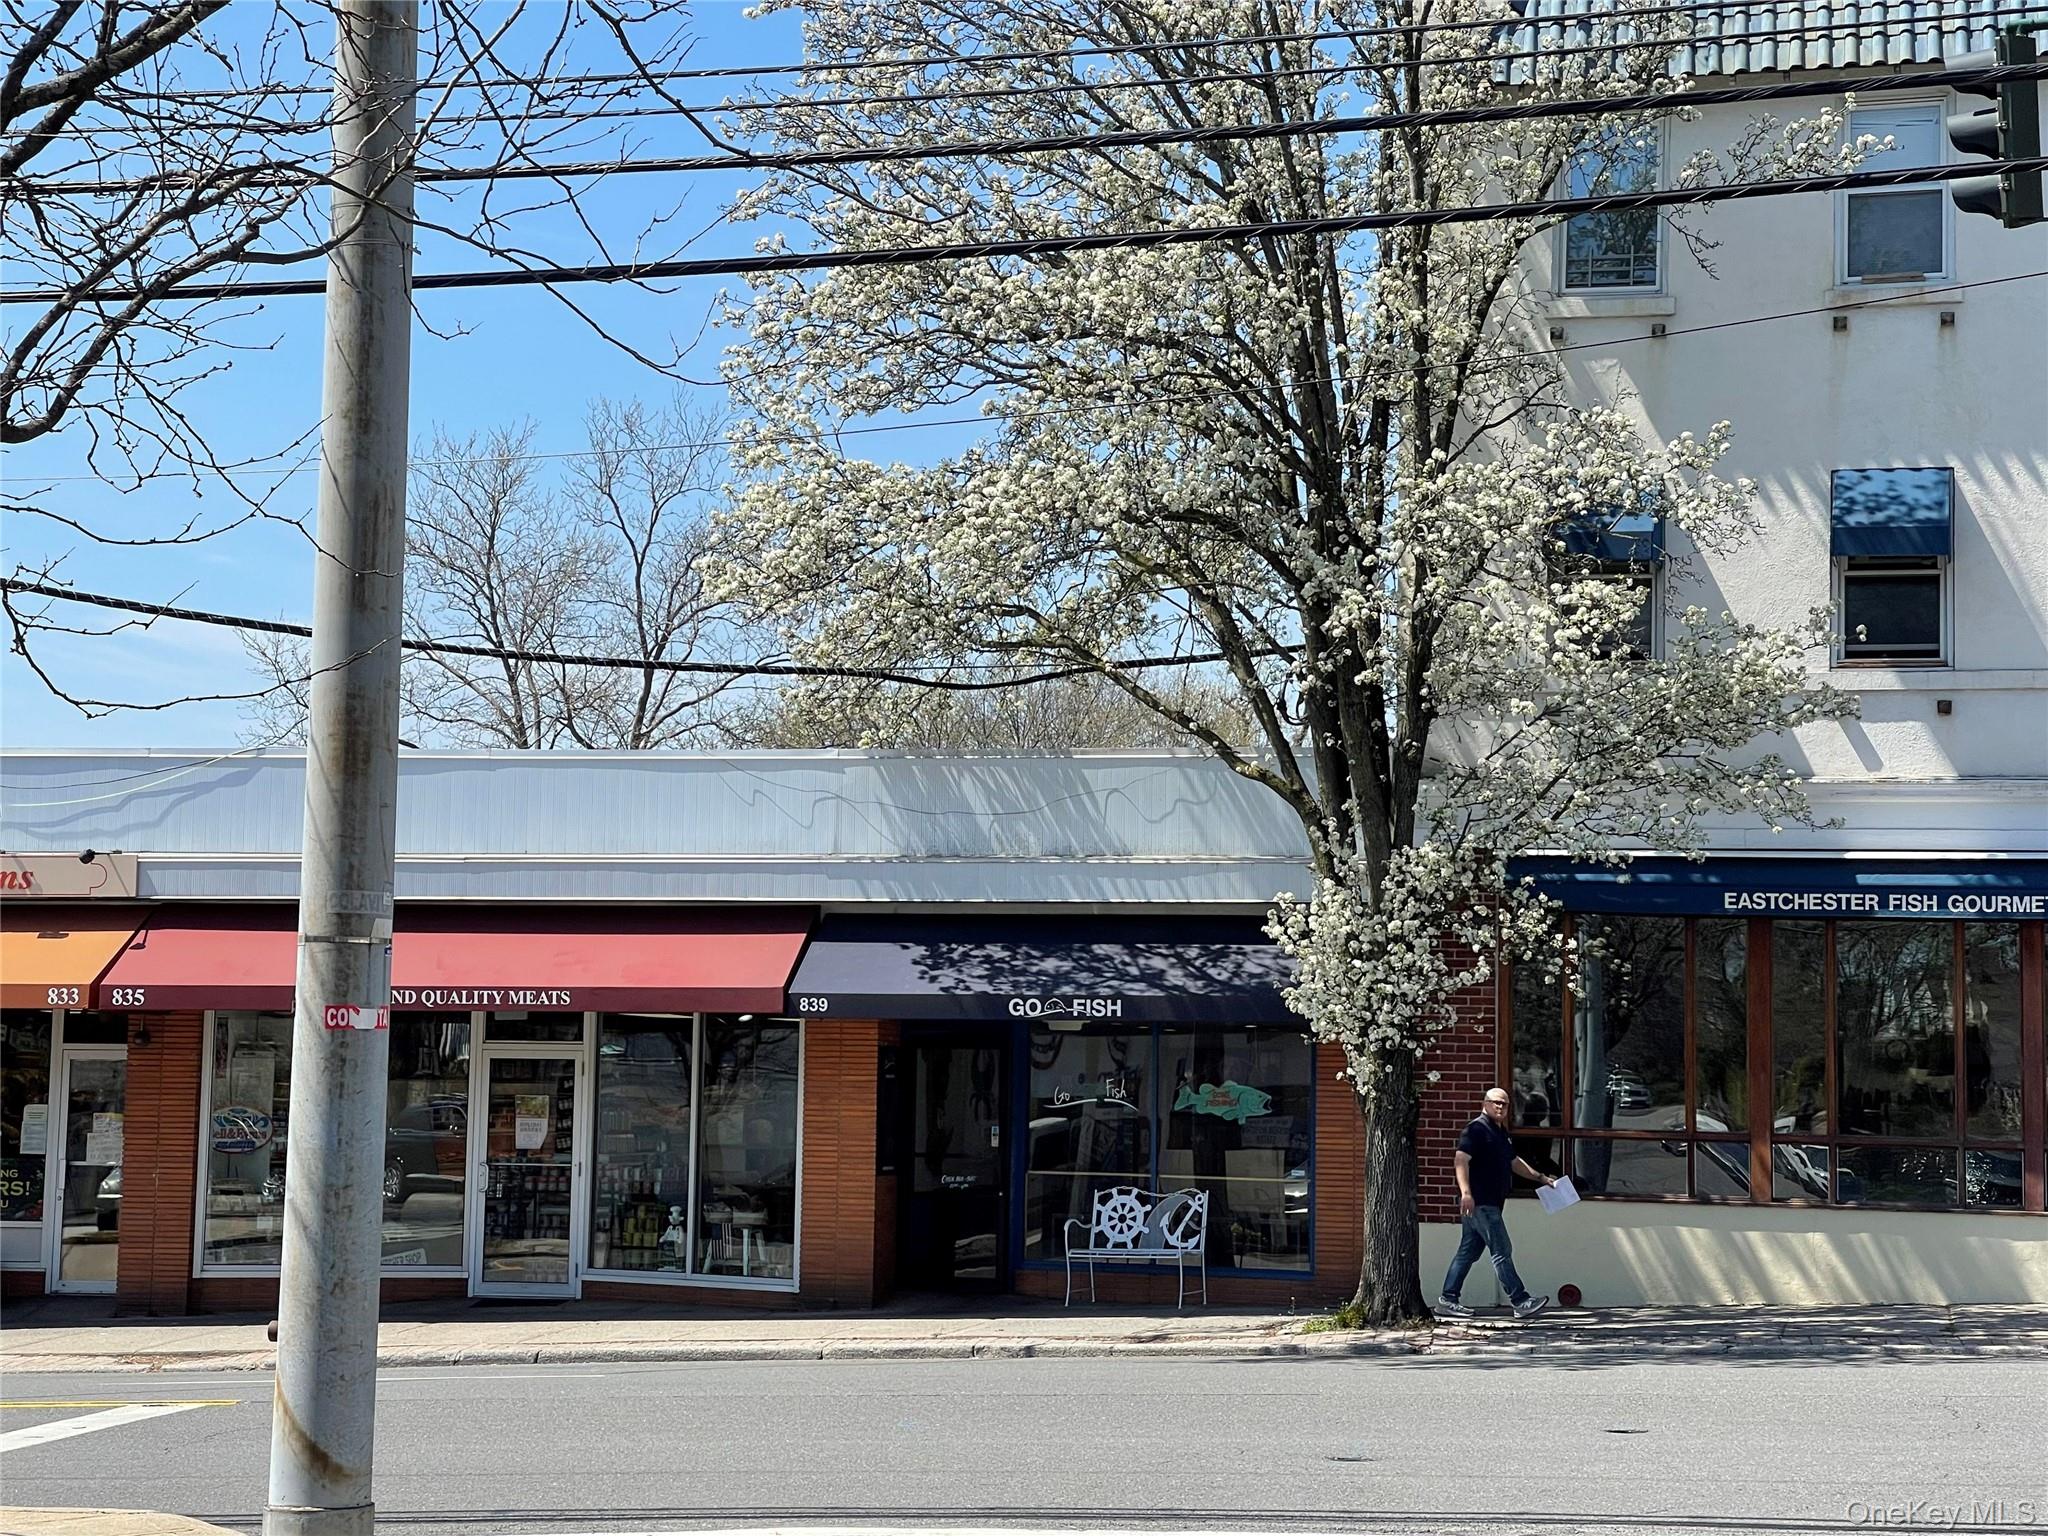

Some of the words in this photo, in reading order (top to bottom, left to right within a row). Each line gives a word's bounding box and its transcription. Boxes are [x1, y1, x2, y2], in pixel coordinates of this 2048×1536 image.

[1724, 892, 1879, 911] EASTCHESTER
[1888, 894, 1938, 912] FISH
[1947, 895, 2048, 913] GOURME
[47, 987, 79, 1005] 833
[112, 988, 145, 1006] 835
[421, 990, 504, 1007] QUALITY
[508, 990, 571, 1005] MEATS
[799, 997, 828, 1012] 839
[1008, 998, 1042, 1017] GO
[1073, 998, 1122, 1017] FISH
[1054, 1086, 1071, 1105] Go
[1105, 1078, 1127, 1099] Fish
